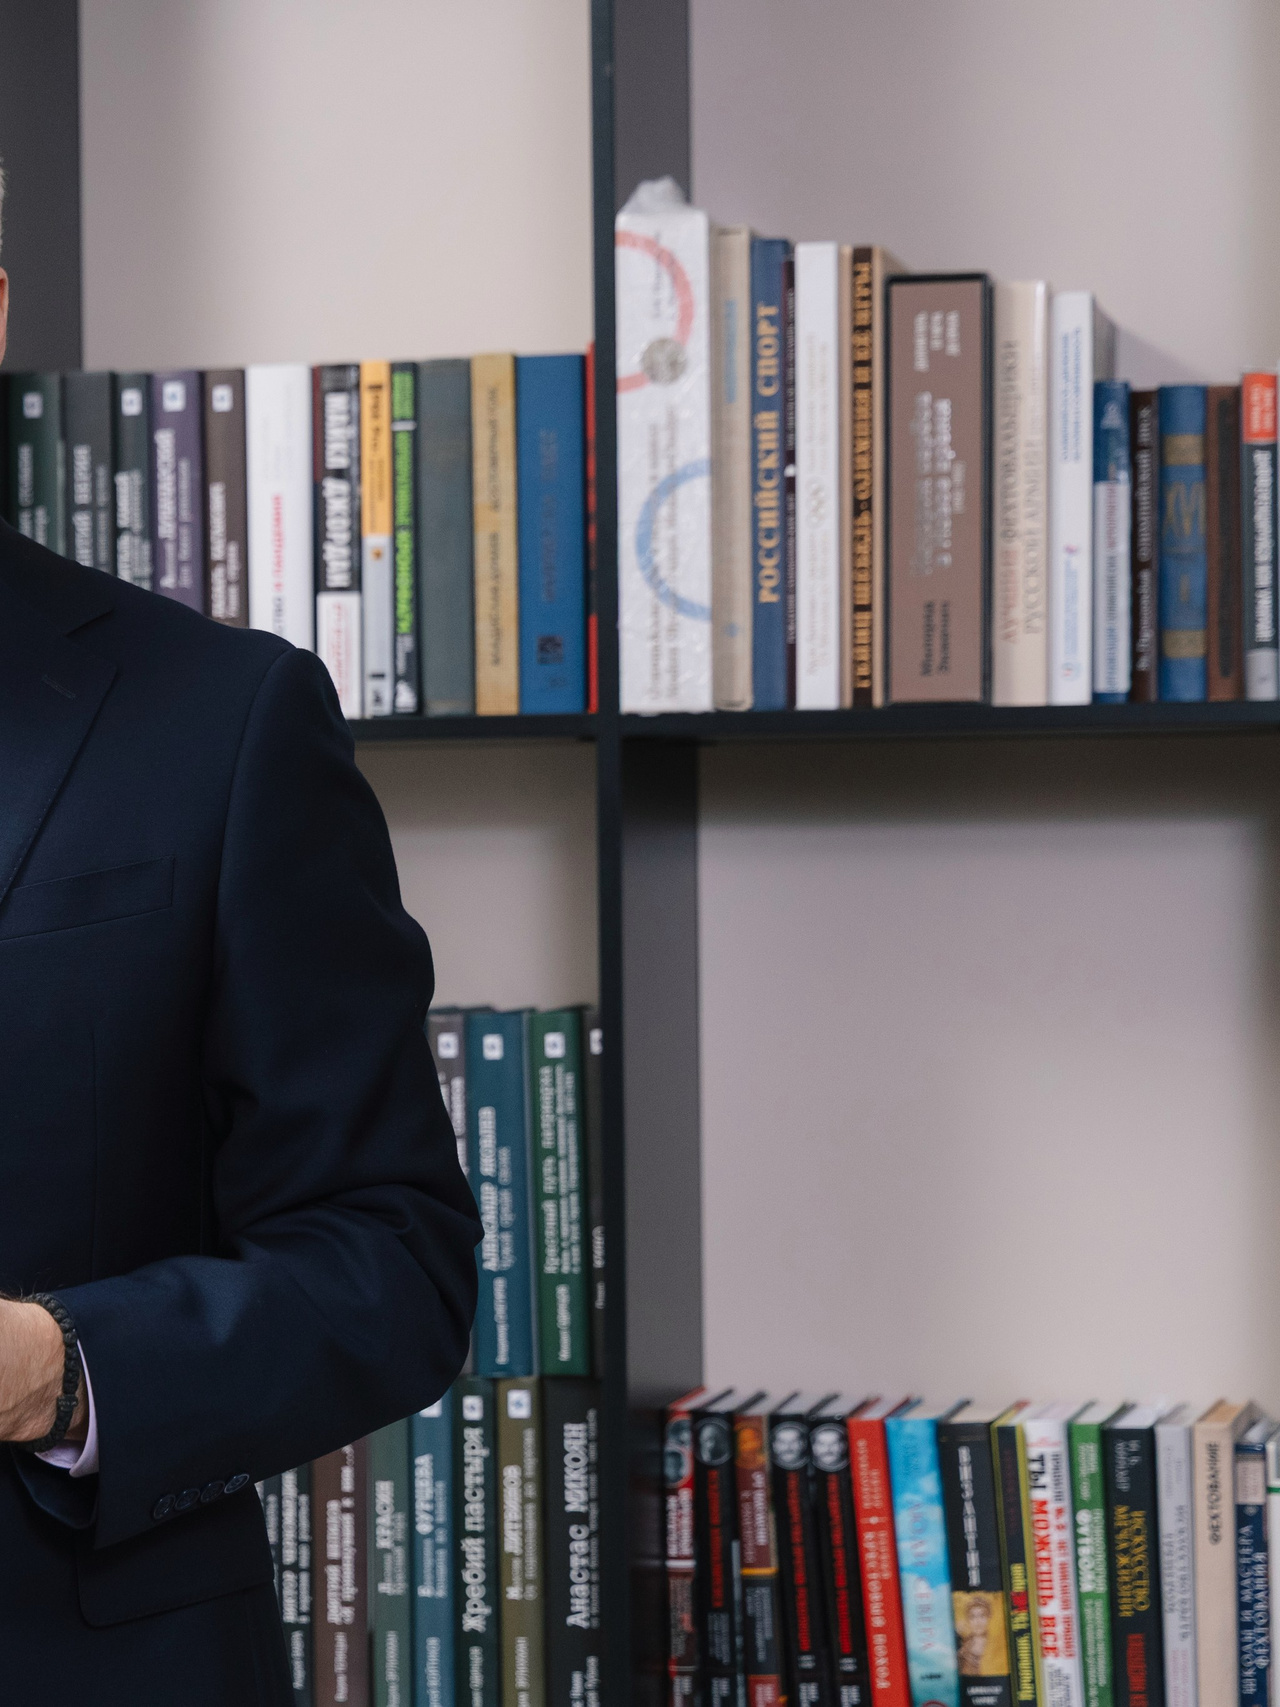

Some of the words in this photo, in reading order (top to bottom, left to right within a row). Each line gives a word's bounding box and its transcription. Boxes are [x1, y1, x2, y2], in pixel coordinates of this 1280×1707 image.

[756, 302, 780, 397] СПОРТ
[324, 391, 354, 470] МАЙКЛ
[322, 478, 352, 589] ДЖОРДАН
[754, 409, 781, 605] РОССИЙСКИЙ
[478, 1106, 498, 1178] ЯКОВЛЕВ
[538, 1065, 558, 1150] патриарха
[540, 1155, 559, 1194] путь
[480, 1182, 500, 1271] АЛЕКСАНДР
[540, 1199, 560, 1274] Крестный
[415, 1453, 434, 1536] ФУРЦЕВА
[464, 1427, 489, 1531] пастыря
[503, 1464, 523, 1556] ЛИТВИНОВ
[565, 1422, 588, 1513] МИКОЯН
[1028, 1452, 1049, 1492] ТЫ
[1205, 1440, 1224, 1547] ФЕХТОВАНИЕ
[376, 1480, 394, 1549] КРАСИН
[1030, 1498, 1057, 1609] МОЖЕШЬ
[1076, 1508, 1095, 1594] ФУТБОЛА
[282, 1570, 297, 1623] ВИКТОР
[324, 1564, 343, 1625] ДМИТРИЙ
[462, 1537, 491, 1632] Жребий
[567, 1523, 591, 1629] Анастас
[863, 1531, 887, 1628] КРЕСТОВЫЙ
[1128, 1510, 1151, 1613] ИСКУССТВО
[913, 1577, 936, 1652] СЕВЕРА
[1038, 1614, 1061, 1660] ВСЕ
[872, 1633, 892, 1690] ПОХОД
[1240, 1630, 1258, 1696] ШКОЛЫ
